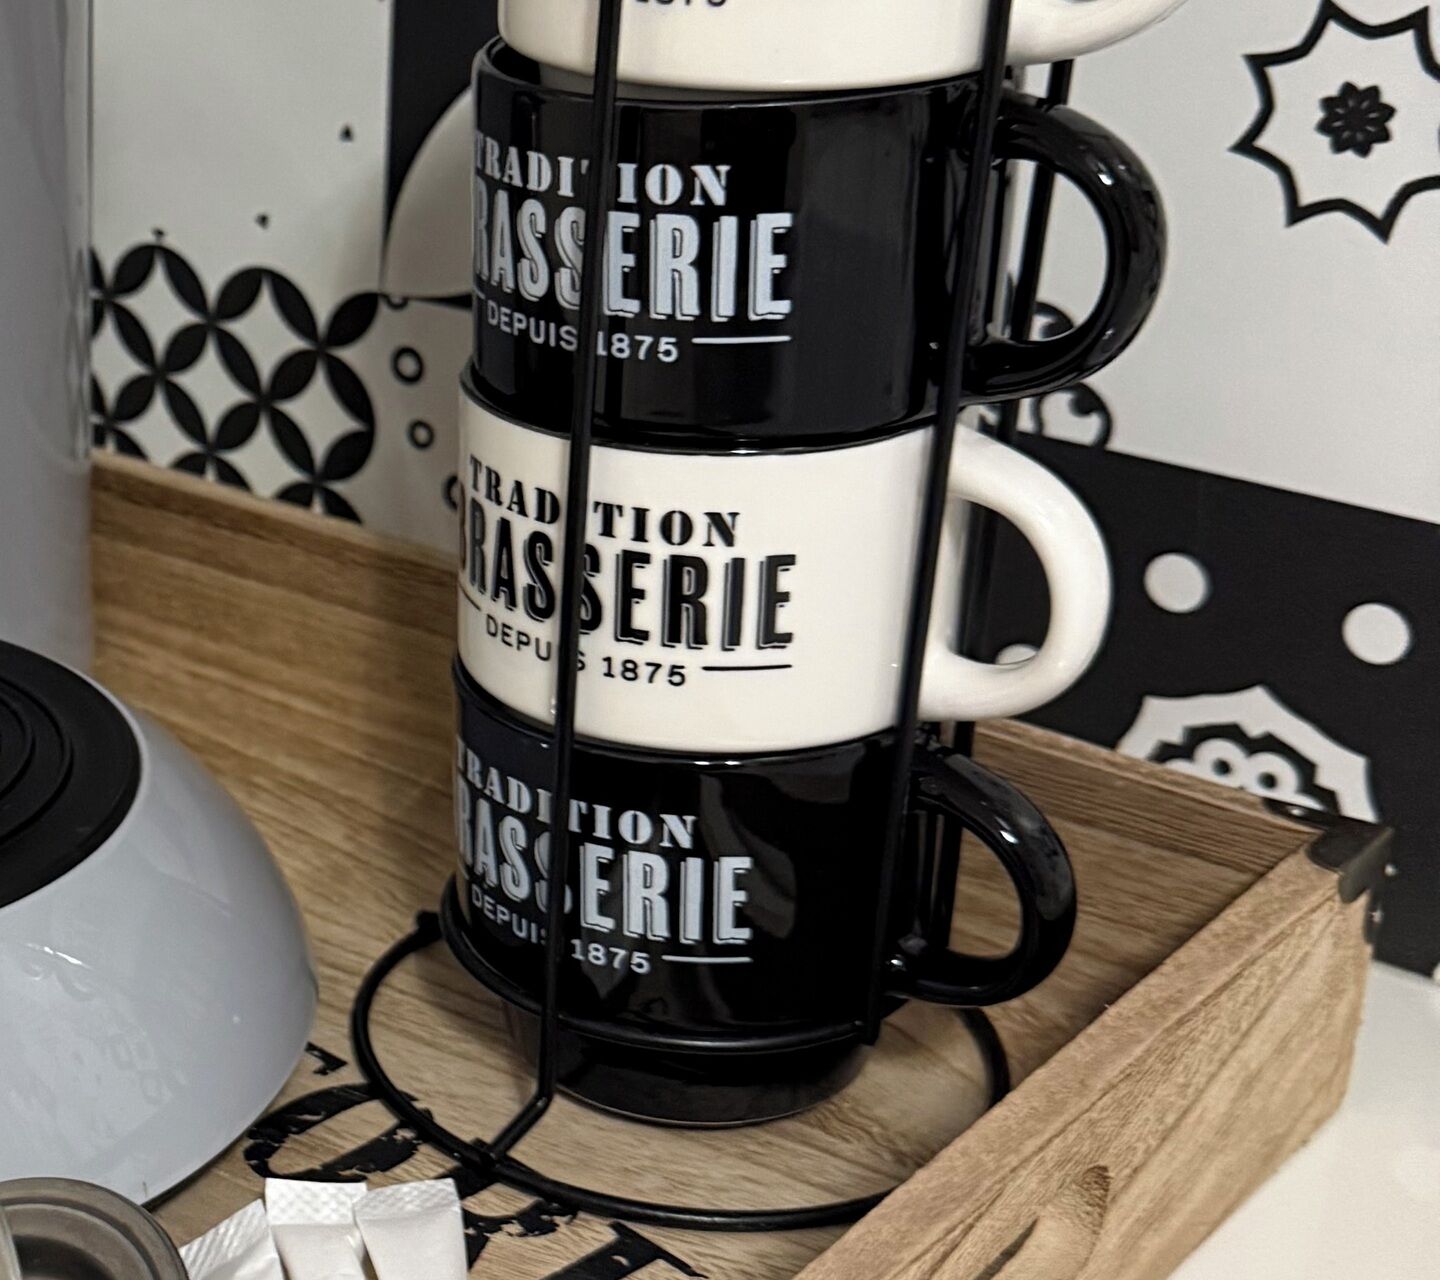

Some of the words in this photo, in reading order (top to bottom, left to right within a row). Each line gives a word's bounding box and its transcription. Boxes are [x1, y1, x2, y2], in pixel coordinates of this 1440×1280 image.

[476, 130, 732, 207] TRADIION
[486, 299, 579, 352] DEPUIS
[596, 330, 680, 363] 1875
[469, 453, 741, 548] TRADTION
[601, 655, 687, 687] 1875
[470, 882, 548, 946] DEPUI
[569, 938, 652, 976] 1875
